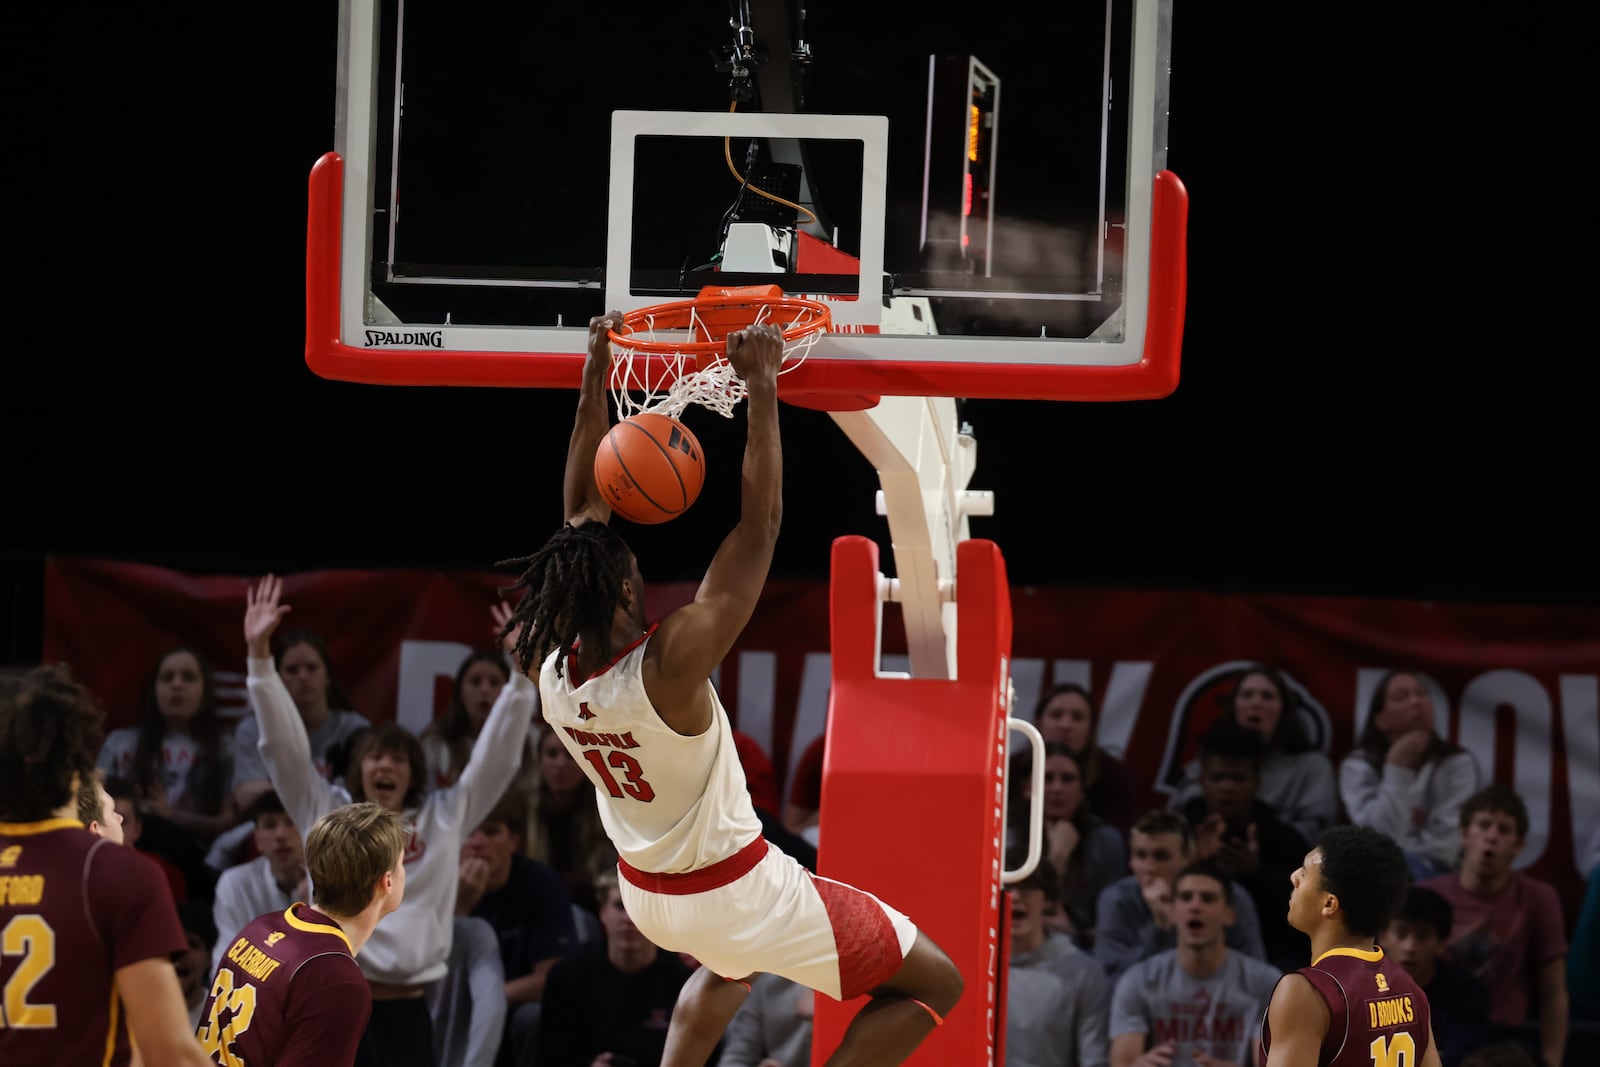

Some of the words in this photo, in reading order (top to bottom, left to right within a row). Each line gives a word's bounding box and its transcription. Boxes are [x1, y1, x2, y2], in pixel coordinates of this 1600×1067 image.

[365, 330, 442, 348] SPALDING
[583, 750, 656, 802] 13
[195, 967, 257, 1067] 32
[1368, 1002, 1378, 1029] D
[1377, 996, 1414, 1027] BROOKS
